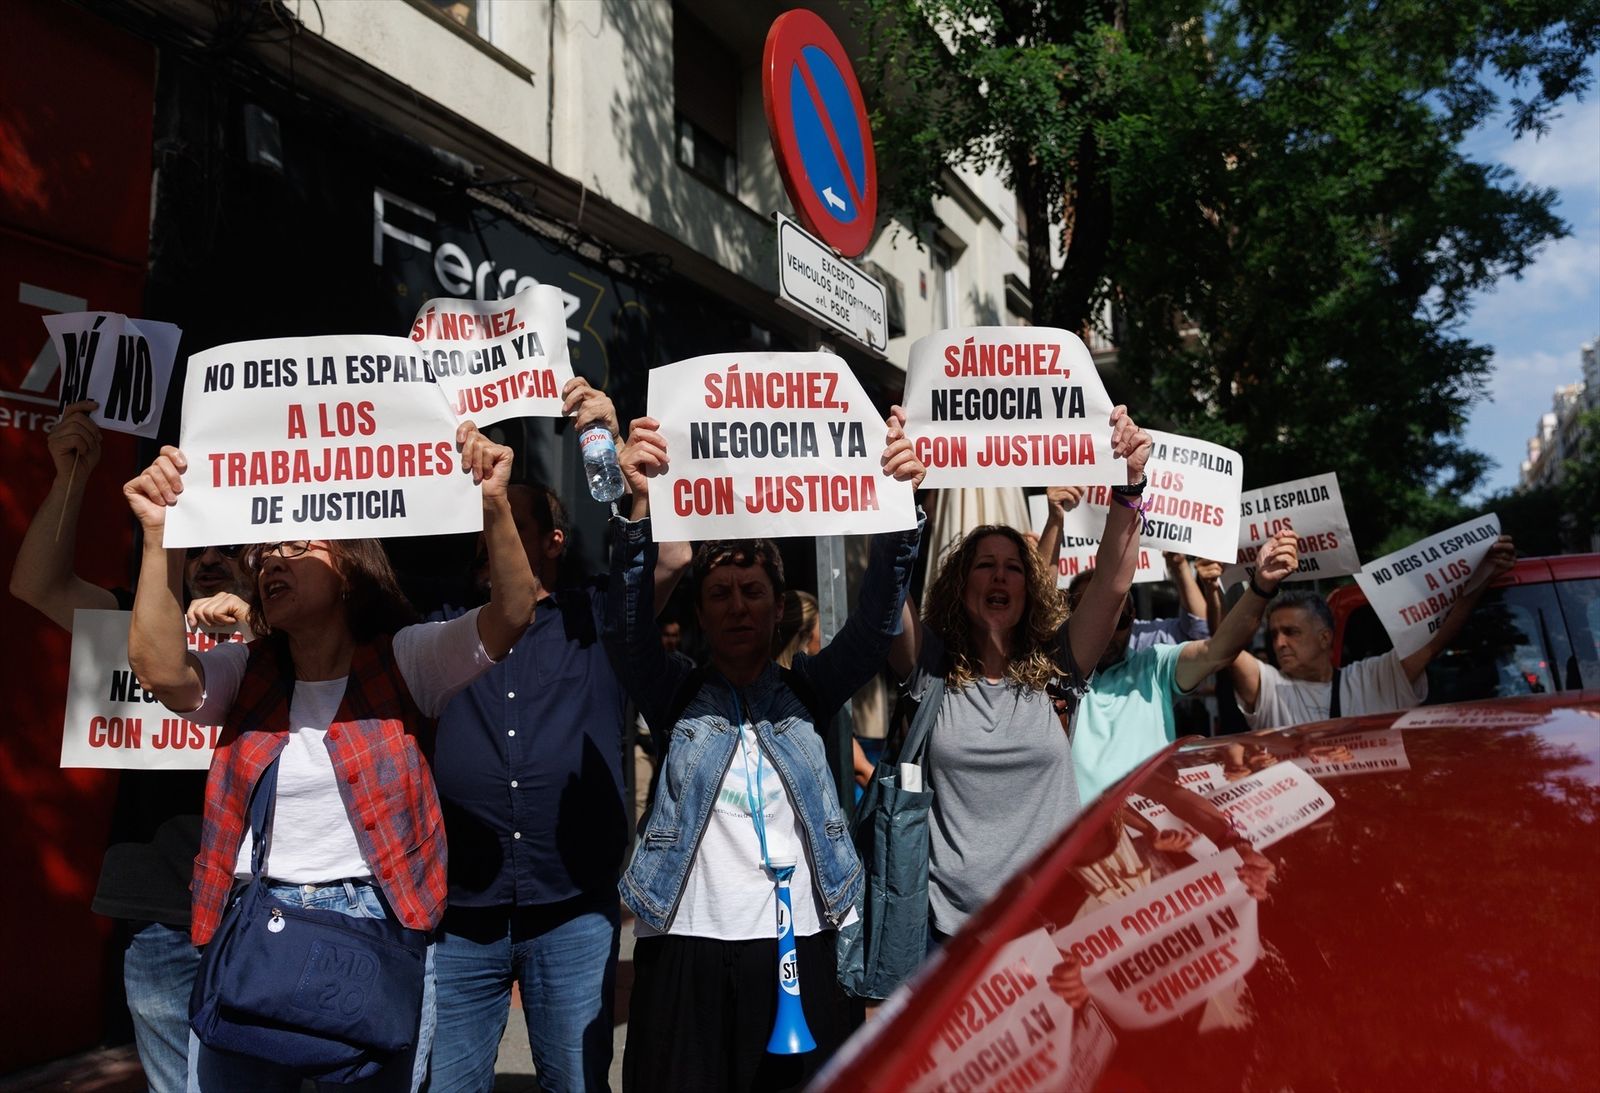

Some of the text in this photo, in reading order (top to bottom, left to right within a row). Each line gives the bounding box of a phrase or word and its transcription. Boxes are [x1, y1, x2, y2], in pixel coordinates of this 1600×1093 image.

[787, 252, 832, 292] VEHICULOS
[821, 257, 855, 290] EXCEPTO
[411, 306, 526, 343] SÁNCHEZ,
[830, 300, 850, 322] PSOE
[18, 281, 88, 393] 7
[424, 331, 545, 378] GOCIA YA
[203, 364, 234, 393] NO
[243, 357, 298, 390] DEIS
[307, 356, 338, 386] LA
[943, 336, 1071, 379] SÁNCHEZ,
[104, 334, 153, 426] NO
[451, 369, 559, 416] JUSTICIA
[703, 363, 850, 414] SÁNCHEZ,
[287, 400, 377, 440] A LOS
[931, 386, 1087, 421] NEGOCIA YA
[690, 421, 867, 460] NEGOCIA YA
[915, 433, 1096, 468] CON JUSTICIA
[1151, 442, 1233, 476] LA ESPALDA
[208, 440, 454, 488] TRABAJADORES
[1151, 468, 1185, 492] LOS
[250, 488, 407, 526] DE JUSTICIA
[673, 474, 880, 517] CON JUSTICIA
[1256, 497, 1271, 514] LA
[1273, 485, 1330, 510] ESPALDA
[1249, 517, 1293, 541] A LOS
[1058, 557, 1079, 576] ON
[1372, 524, 1498, 585] NO DEIS LA ESPALDA
[1424, 558, 1472, 591] A LOS
[88, 715, 218, 750] CON JUST
